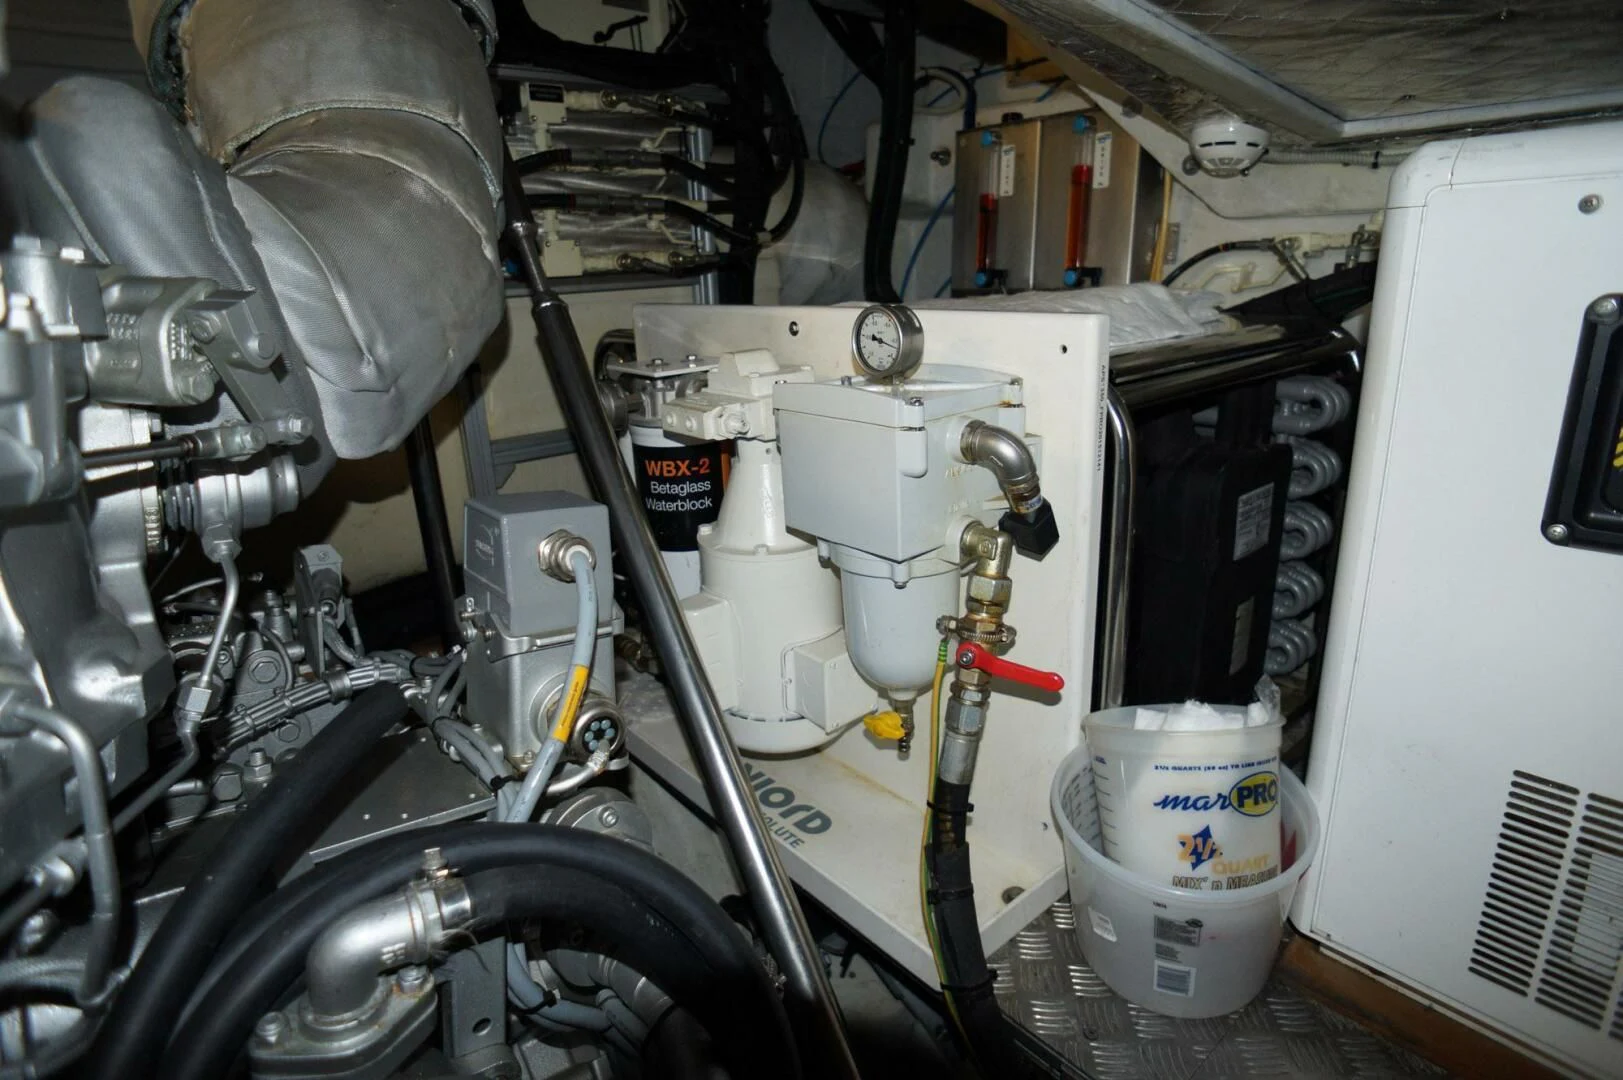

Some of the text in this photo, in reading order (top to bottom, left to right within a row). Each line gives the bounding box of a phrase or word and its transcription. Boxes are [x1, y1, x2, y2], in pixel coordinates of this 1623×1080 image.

[645, 457, 711, 477] WBX-2
[650, 481, 711, 496] Betaglass
[645, 496, 713, 511] Waterblock
[1212, 854, 1271, 876] QUART
